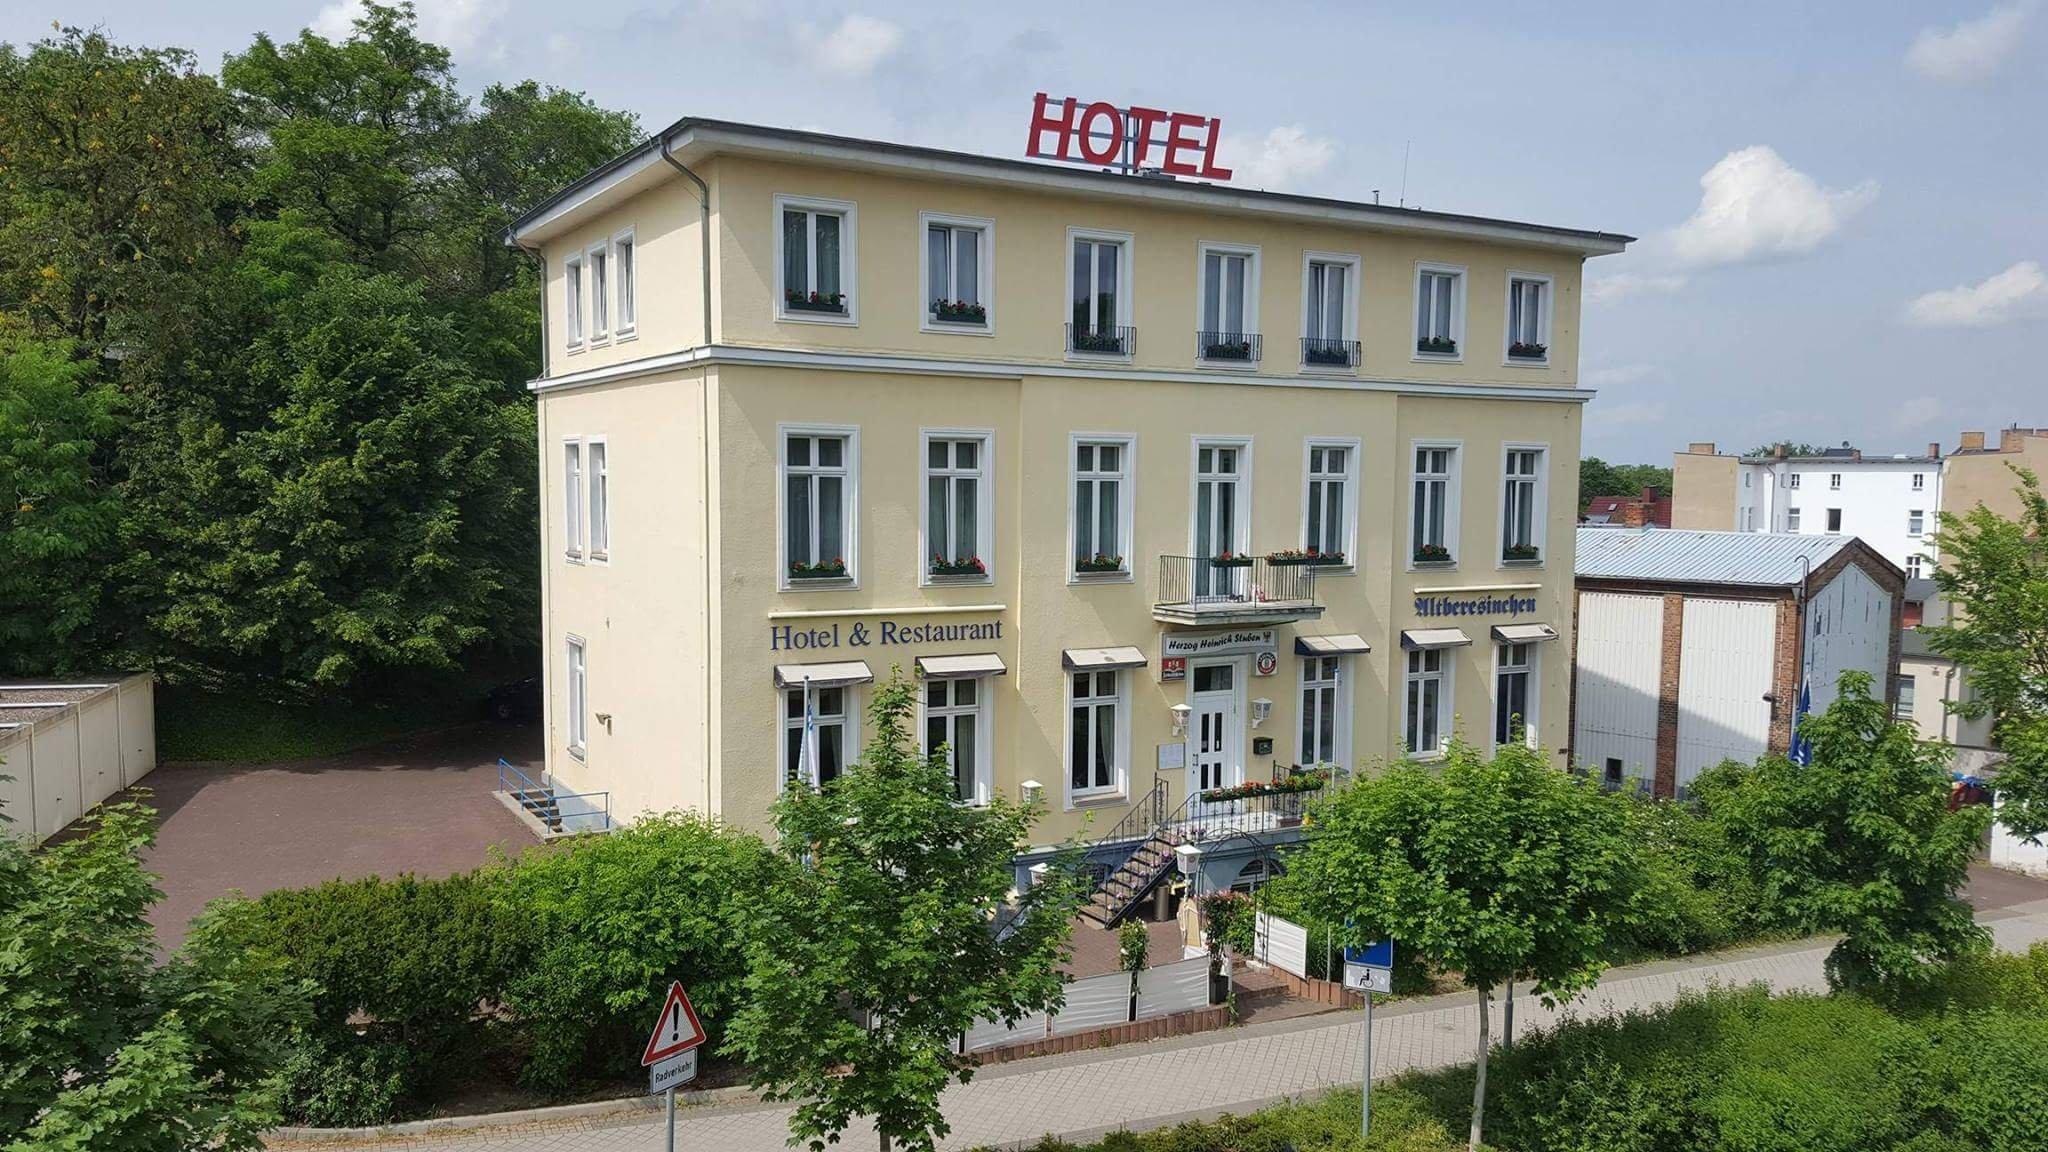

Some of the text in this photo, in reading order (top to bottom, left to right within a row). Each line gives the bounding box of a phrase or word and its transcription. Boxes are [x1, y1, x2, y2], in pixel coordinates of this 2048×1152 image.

[1026, 92, 1233, 180] HOTEL
[1414, 594, 1537, 619] Altberesinchen
[771, 619, 1003, 650] Hotel & Restaurant
[1168, 633, 1261, 652] Herzog Heinrich Stuben
[655, 1061, 693, 1084] Radverkehr
